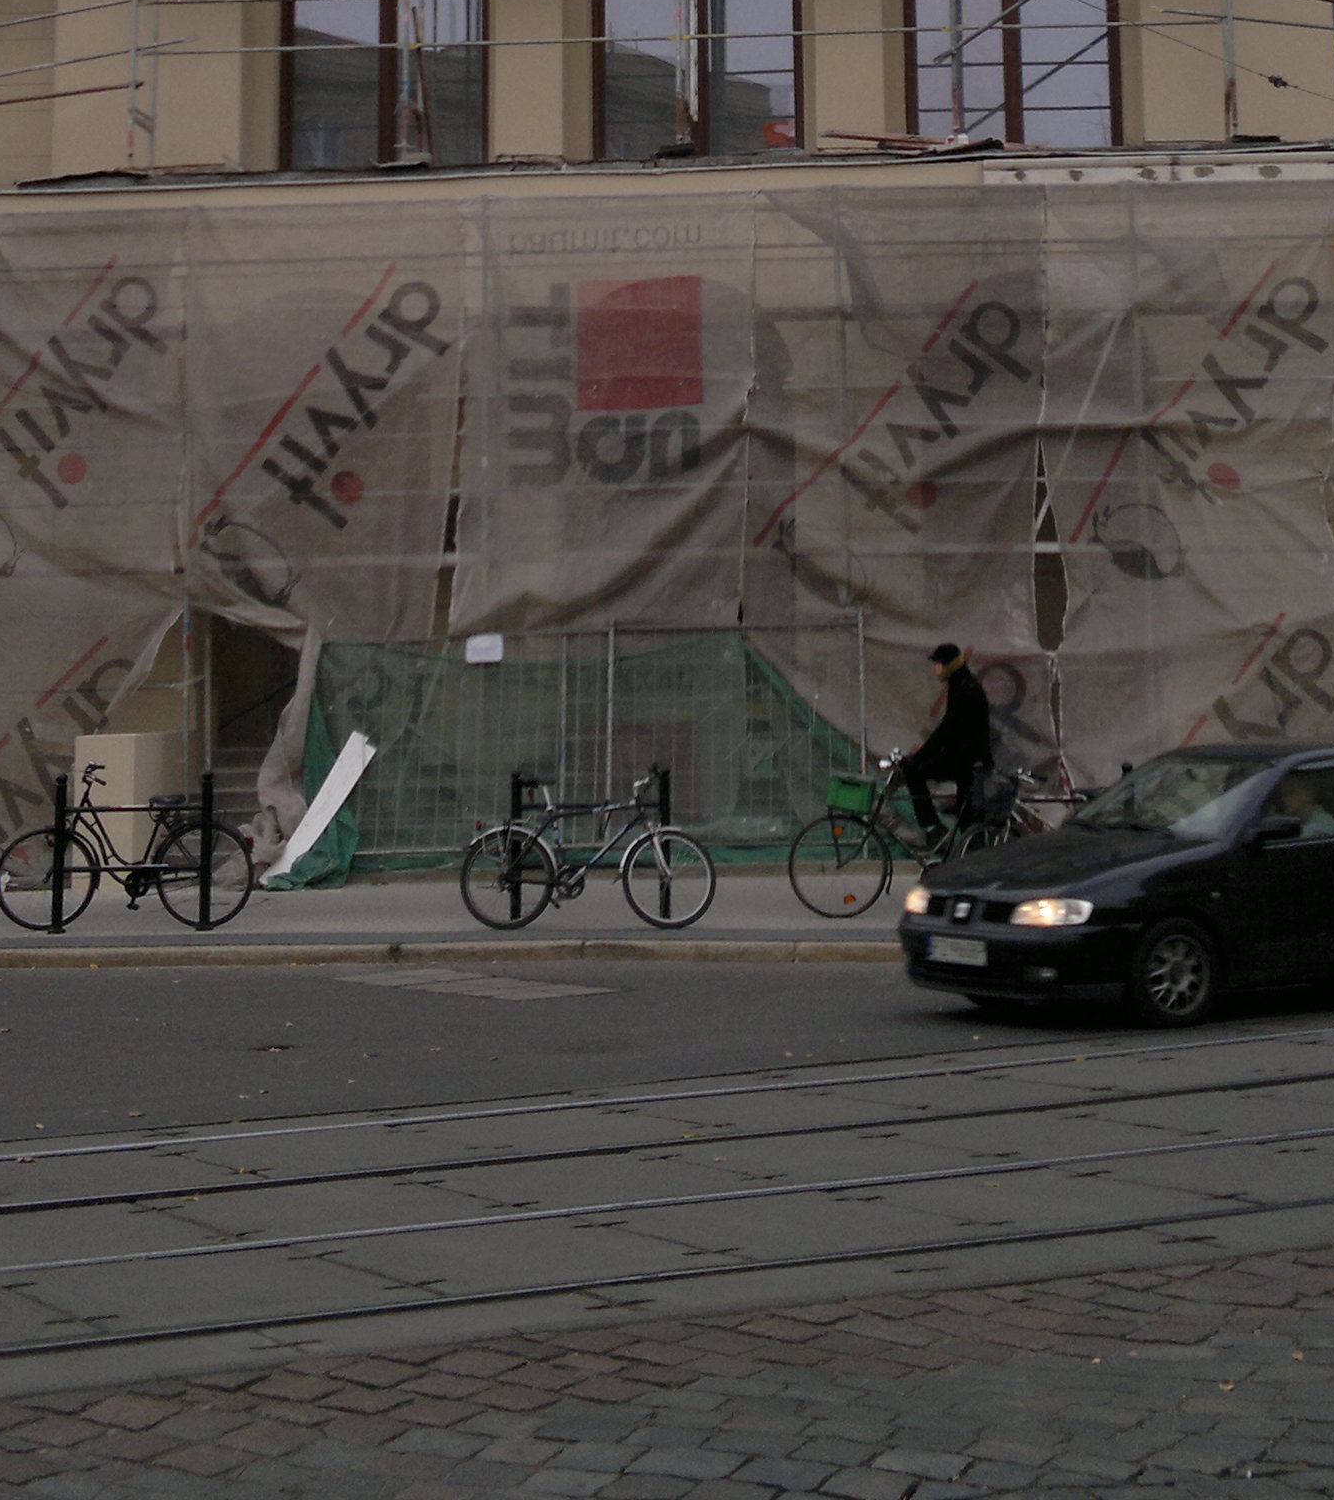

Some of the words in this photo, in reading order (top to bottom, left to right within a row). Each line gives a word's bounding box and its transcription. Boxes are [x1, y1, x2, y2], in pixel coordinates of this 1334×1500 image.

[262, 281, 450, 530] dryvit
[839, 301, 1032, 534] dryvit
[1141, 277, 1329, 505] dryvit
